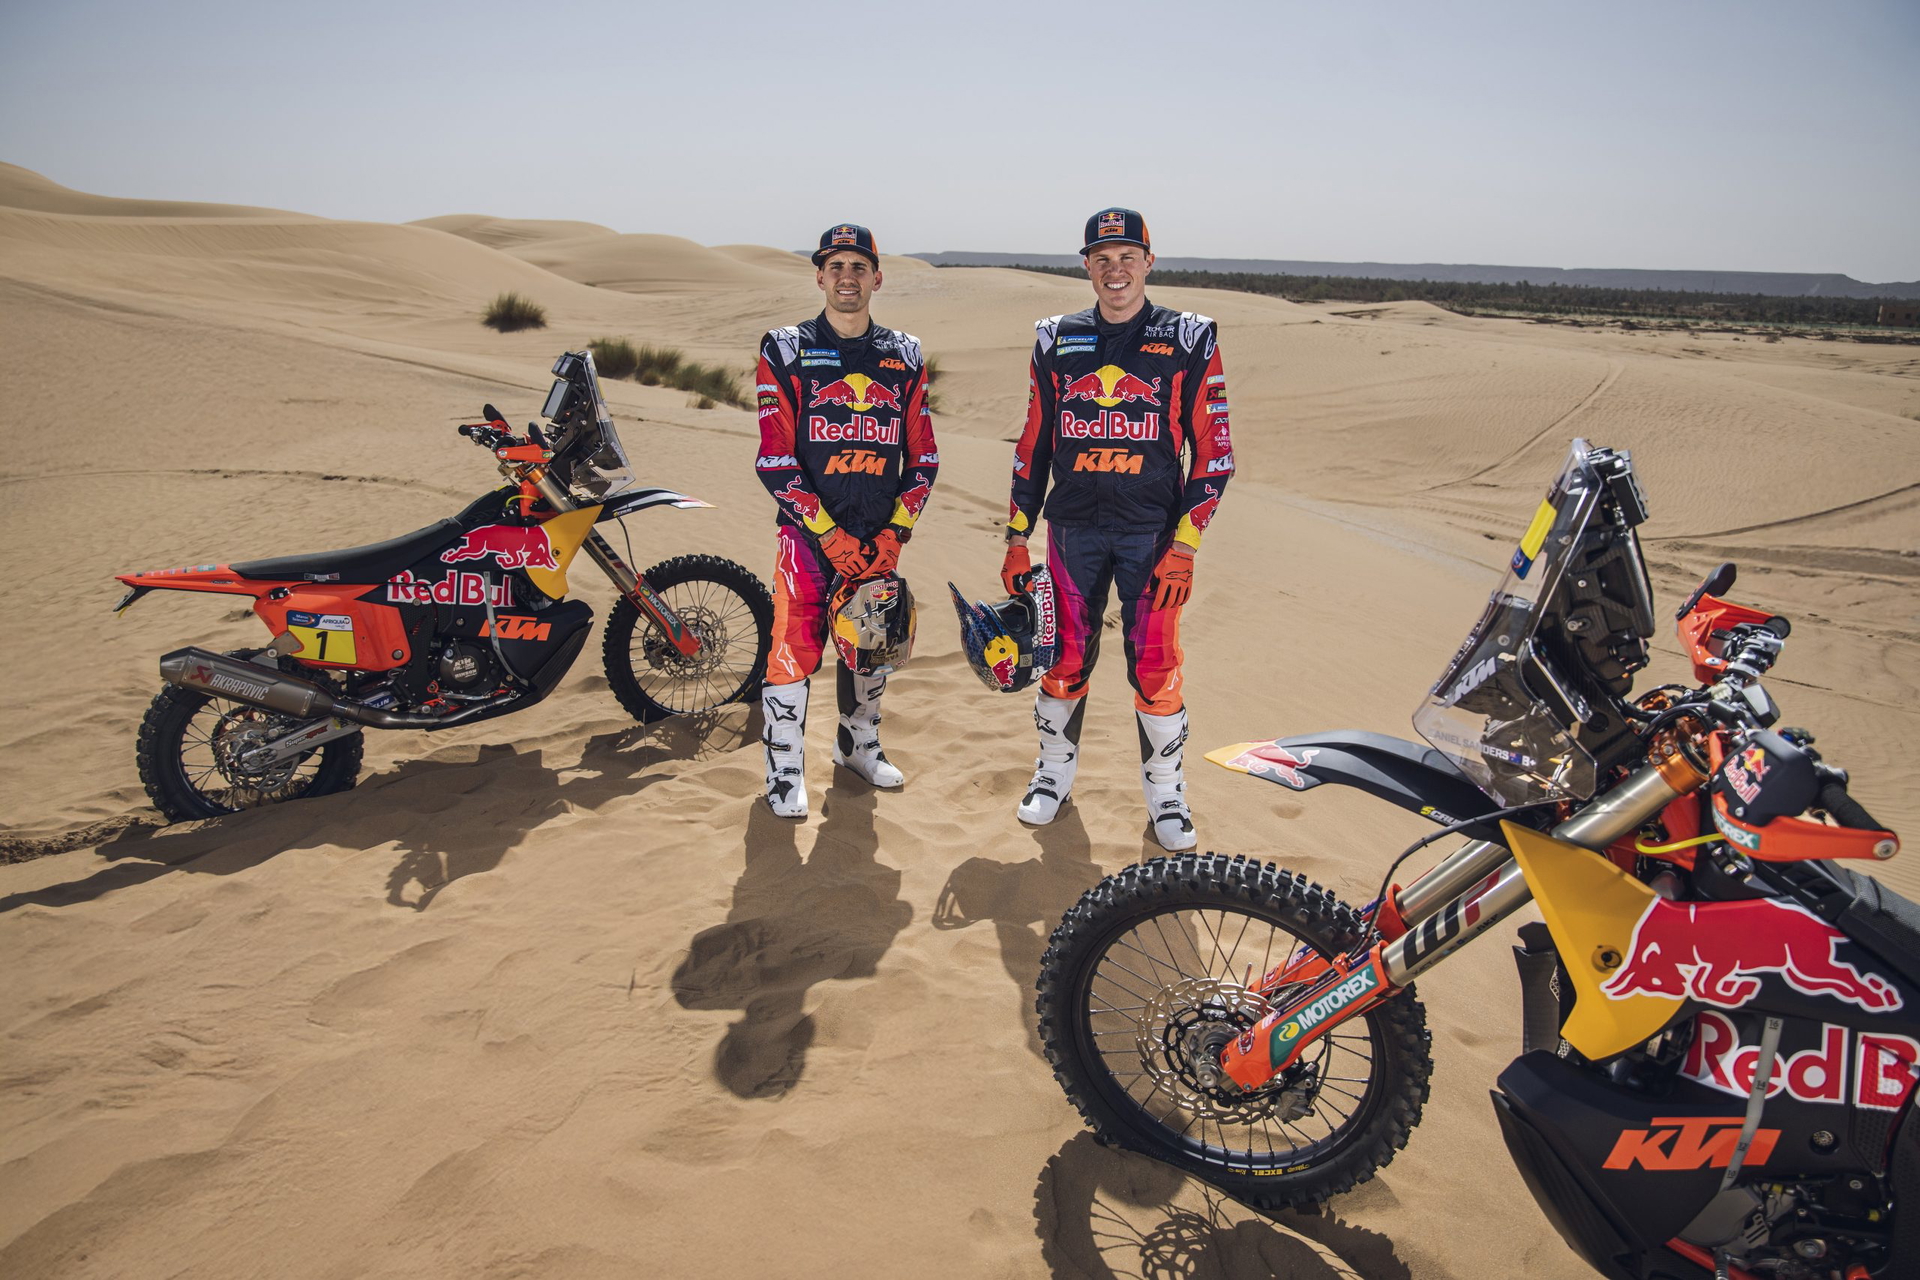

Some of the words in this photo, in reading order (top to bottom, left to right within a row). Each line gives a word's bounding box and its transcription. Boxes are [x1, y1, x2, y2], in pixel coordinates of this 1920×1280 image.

[1140, 343, 1175, 356] KTM
[879, 358, 906, 371] KTM
[809, 414, 861, 442] Red
[863, 416, 900, 445] Bull
[1061, 410, 1107, 440] Red
[1109, 411, 1161, 441] Bull
[756, 454, 798, 469] KTM
[823, 449, 887, 476] KTM
[1072, 448, 1144, 475] KTM
[648, 594, 679, 627] MOTOREX
[478, 614, 552, 641] KTM
[1041, 613, 1056, 647] Red
[316, 630, 329, 660] 1
[1454, 657, 1497, 701] KTM
[1463, 739, 1509, 760] SANDERS
[1297, 970, 1375, 1031] MOTOREX
[1768, 1019, 1780, 1030] 16
[1678, 1010, 1849, 1104] Red
[1602, 1117, 1783, 1171] KTM
[1252, 1168, 1283, 1176] EXCEL
